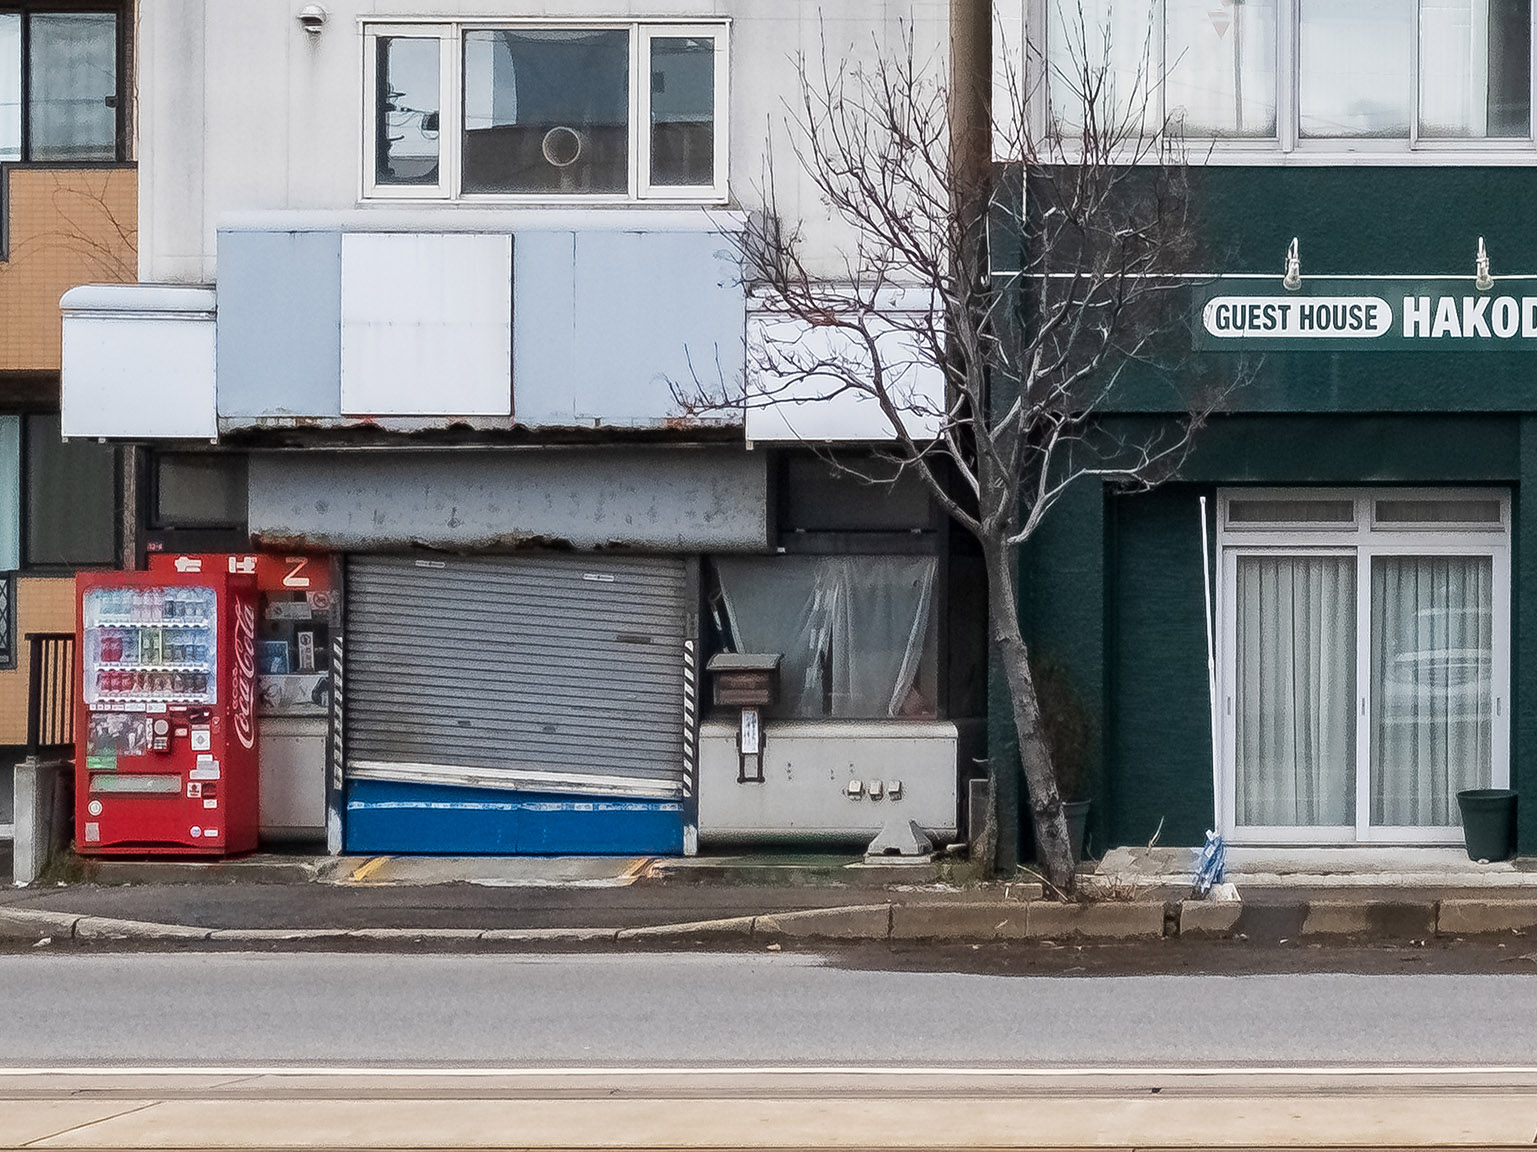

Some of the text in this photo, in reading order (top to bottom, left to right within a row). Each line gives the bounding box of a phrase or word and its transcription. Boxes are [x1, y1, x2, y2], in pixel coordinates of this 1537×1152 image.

[1214, 304, 1291, 332] GUEST
[1299, 304, 1379, 332] HOUSE
[234, 594, 256, 749] Coca-Cola
